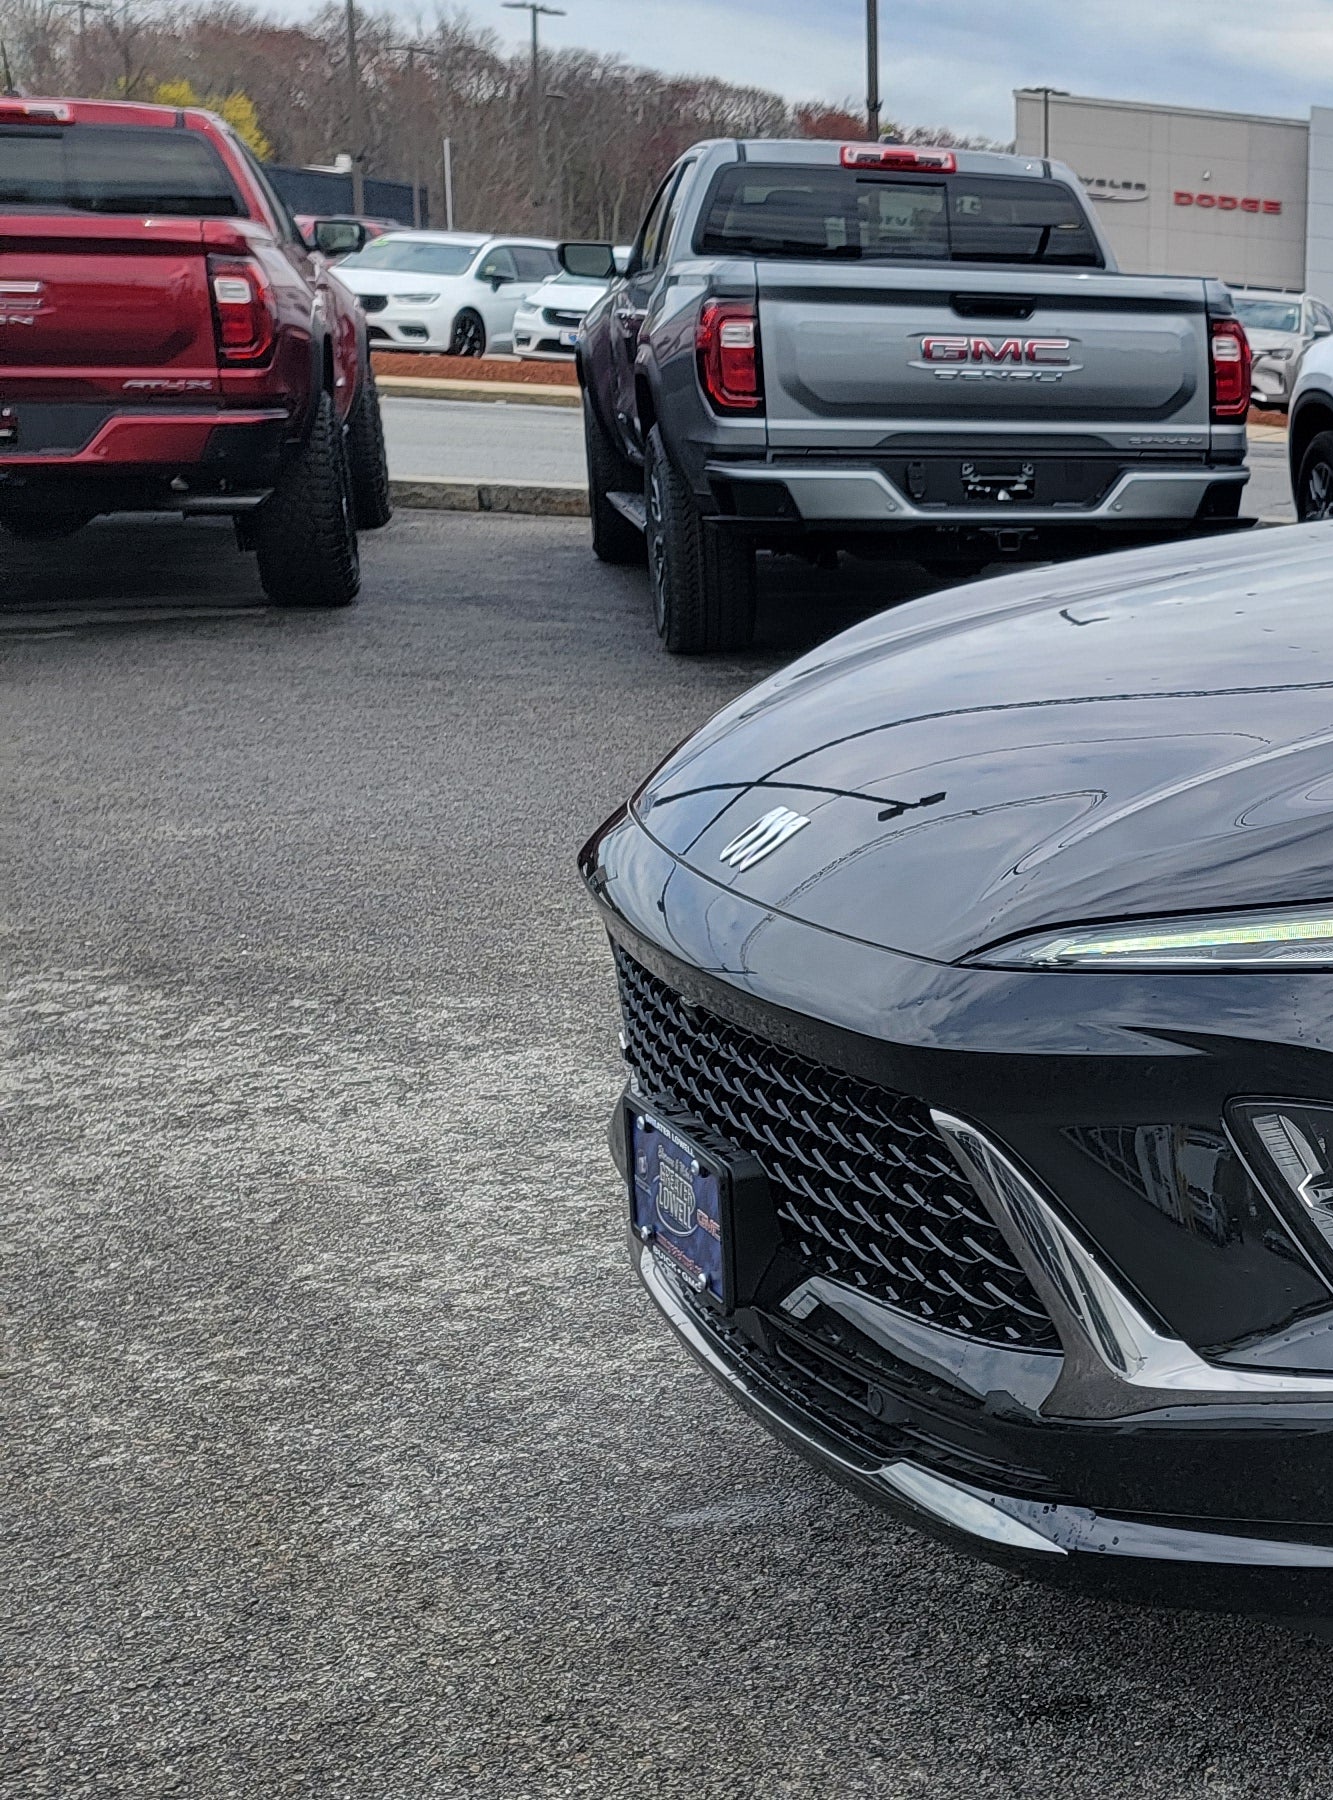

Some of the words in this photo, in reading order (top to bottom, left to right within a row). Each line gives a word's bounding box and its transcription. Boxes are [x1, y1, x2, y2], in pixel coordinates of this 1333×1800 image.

[1079, 175, 1146, 190] YSLER
[1174, 191, 1282, 214] DODGE
[921, 336, 1071, 365] GMC
[672, 1133, 696, 1158] LOWELL
[659, 1161, 693, 1207] GREATER
[658, 1182, 692, 1230] LOWELL
[696, 1208, 721, 1241] GMC
[652, 1245, 677, 1273] BUICK
